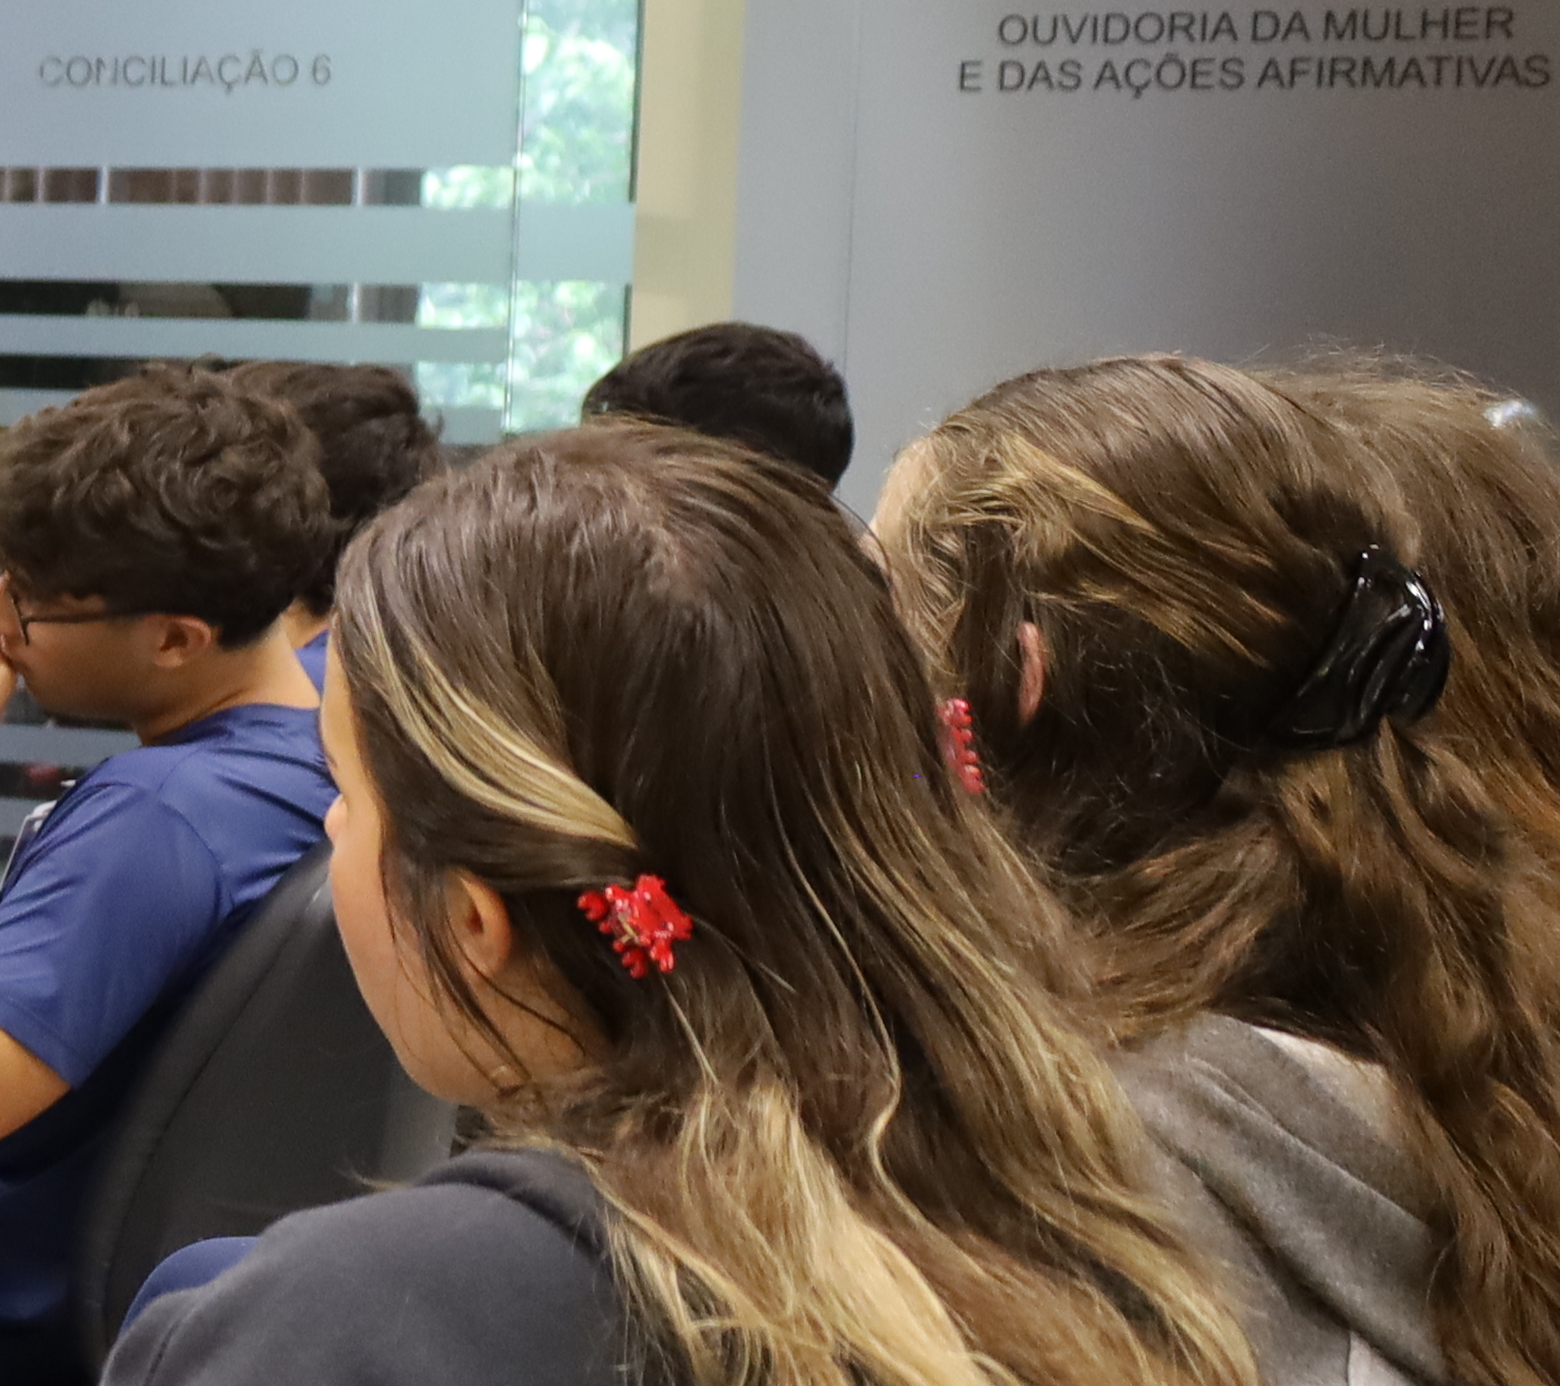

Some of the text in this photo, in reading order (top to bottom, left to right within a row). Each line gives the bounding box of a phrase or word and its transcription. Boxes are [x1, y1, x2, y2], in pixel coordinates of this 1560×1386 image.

[997, 5, 1515, 47] OUVIDORIA DA MULHER
[39, 48, 332, 96] CONCILIAÇÃO 6
[958, 51, 1551, 99] E DAS AÇÕES AFIRMATIVAS
